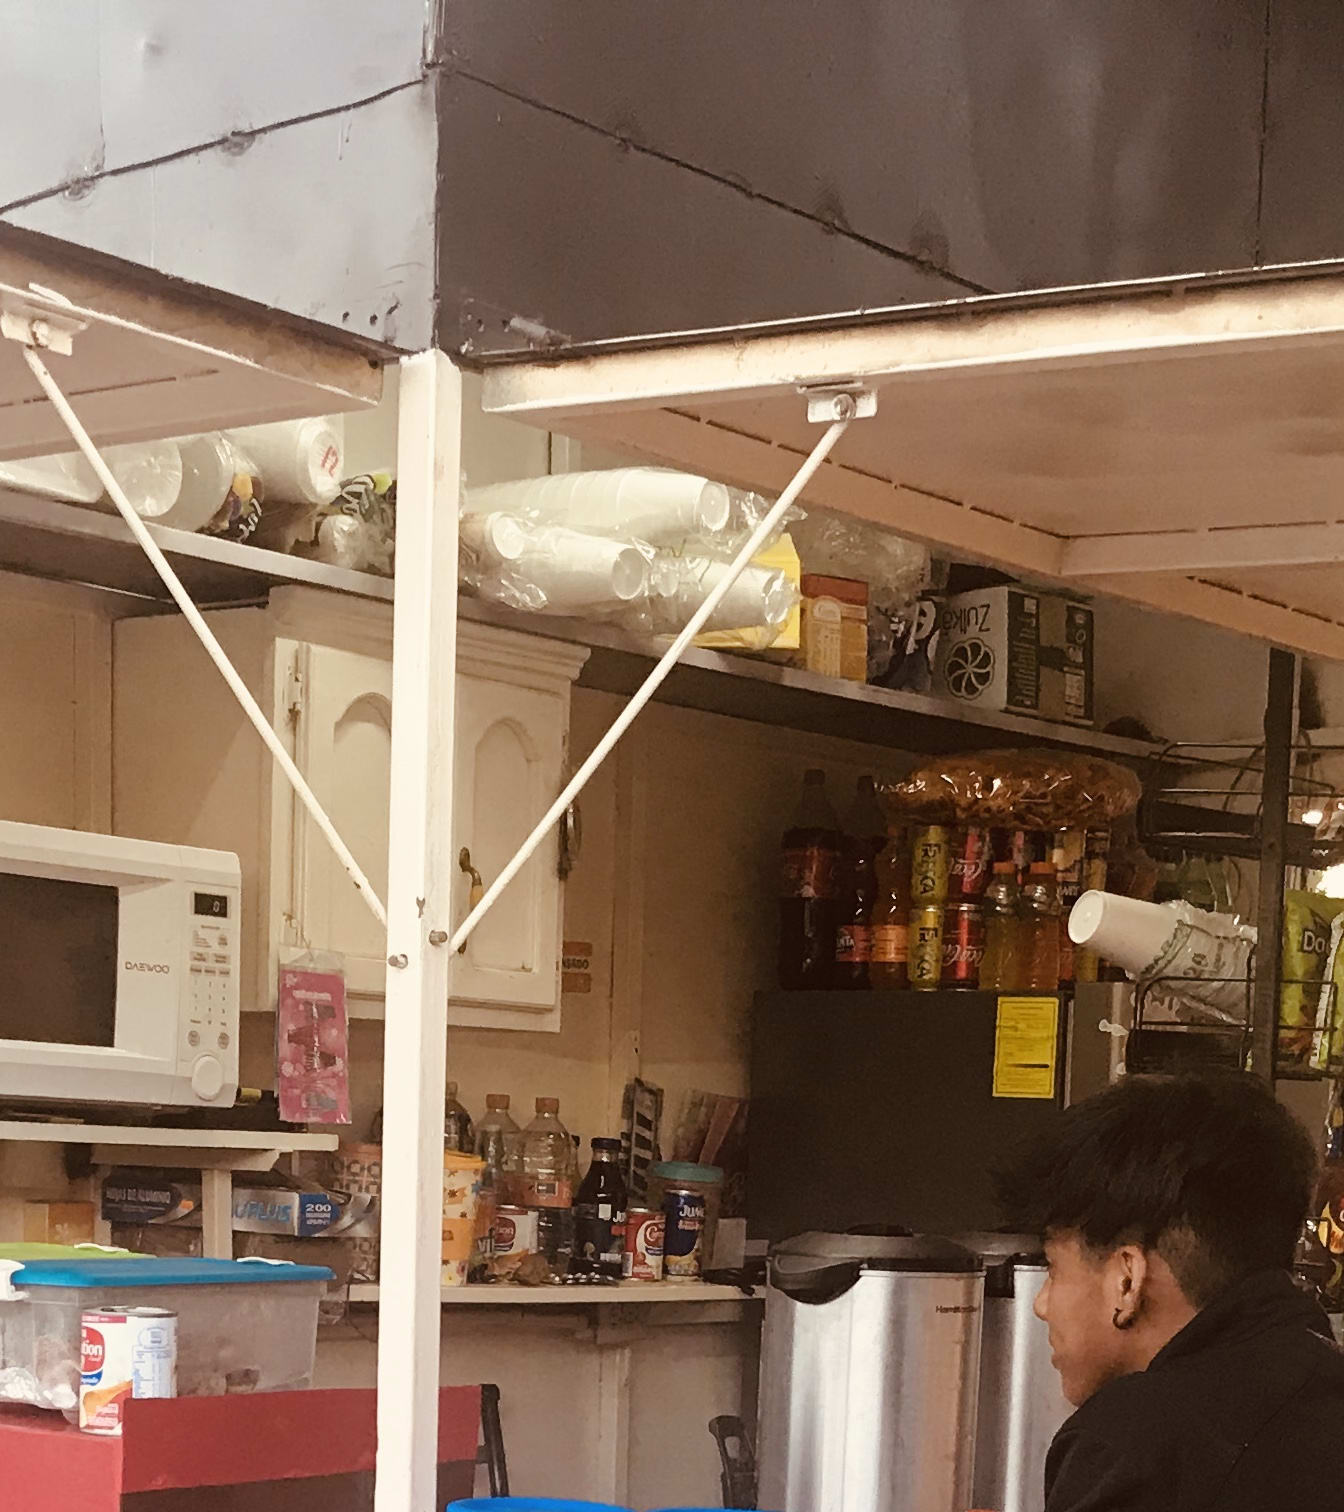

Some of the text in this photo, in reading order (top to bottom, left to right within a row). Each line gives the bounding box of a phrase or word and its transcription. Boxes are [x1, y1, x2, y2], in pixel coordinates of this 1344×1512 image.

[941, 604, 991, 634] Zulka
[125, 961, 170, 974] DAEWOO
[305, 1203, 332, 1212] 200
